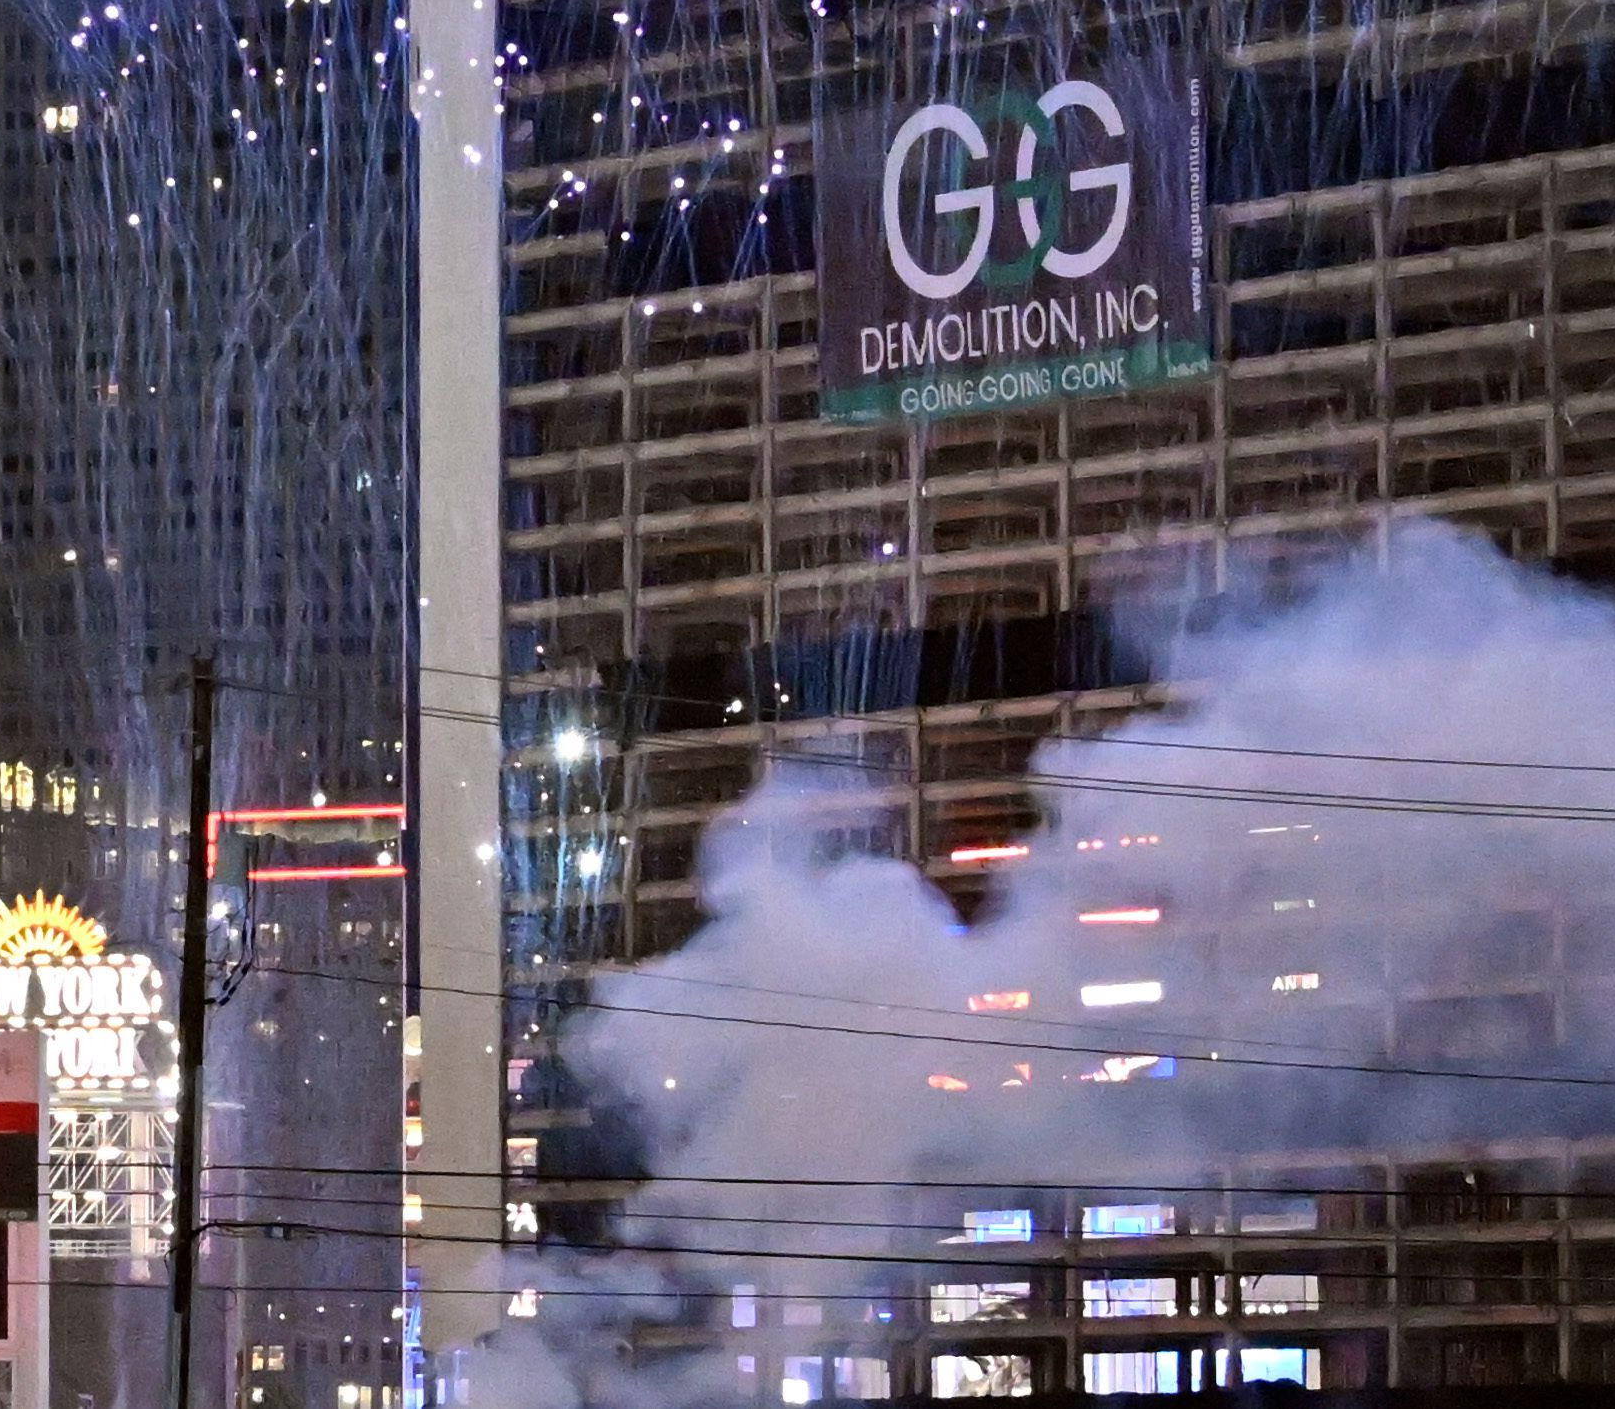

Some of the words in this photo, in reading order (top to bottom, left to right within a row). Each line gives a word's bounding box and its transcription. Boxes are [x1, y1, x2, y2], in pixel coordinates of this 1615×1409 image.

[860, 297, 1086, 375] DEMOLITION,
[1095, 283, 1170, 339] INC.
[899, 379, 975, 415] GOING
[978, 367, 1051, 403] GOING
[1061, 356, 1126, 392] GONE
[36, 966, 152, 1016] YORK
